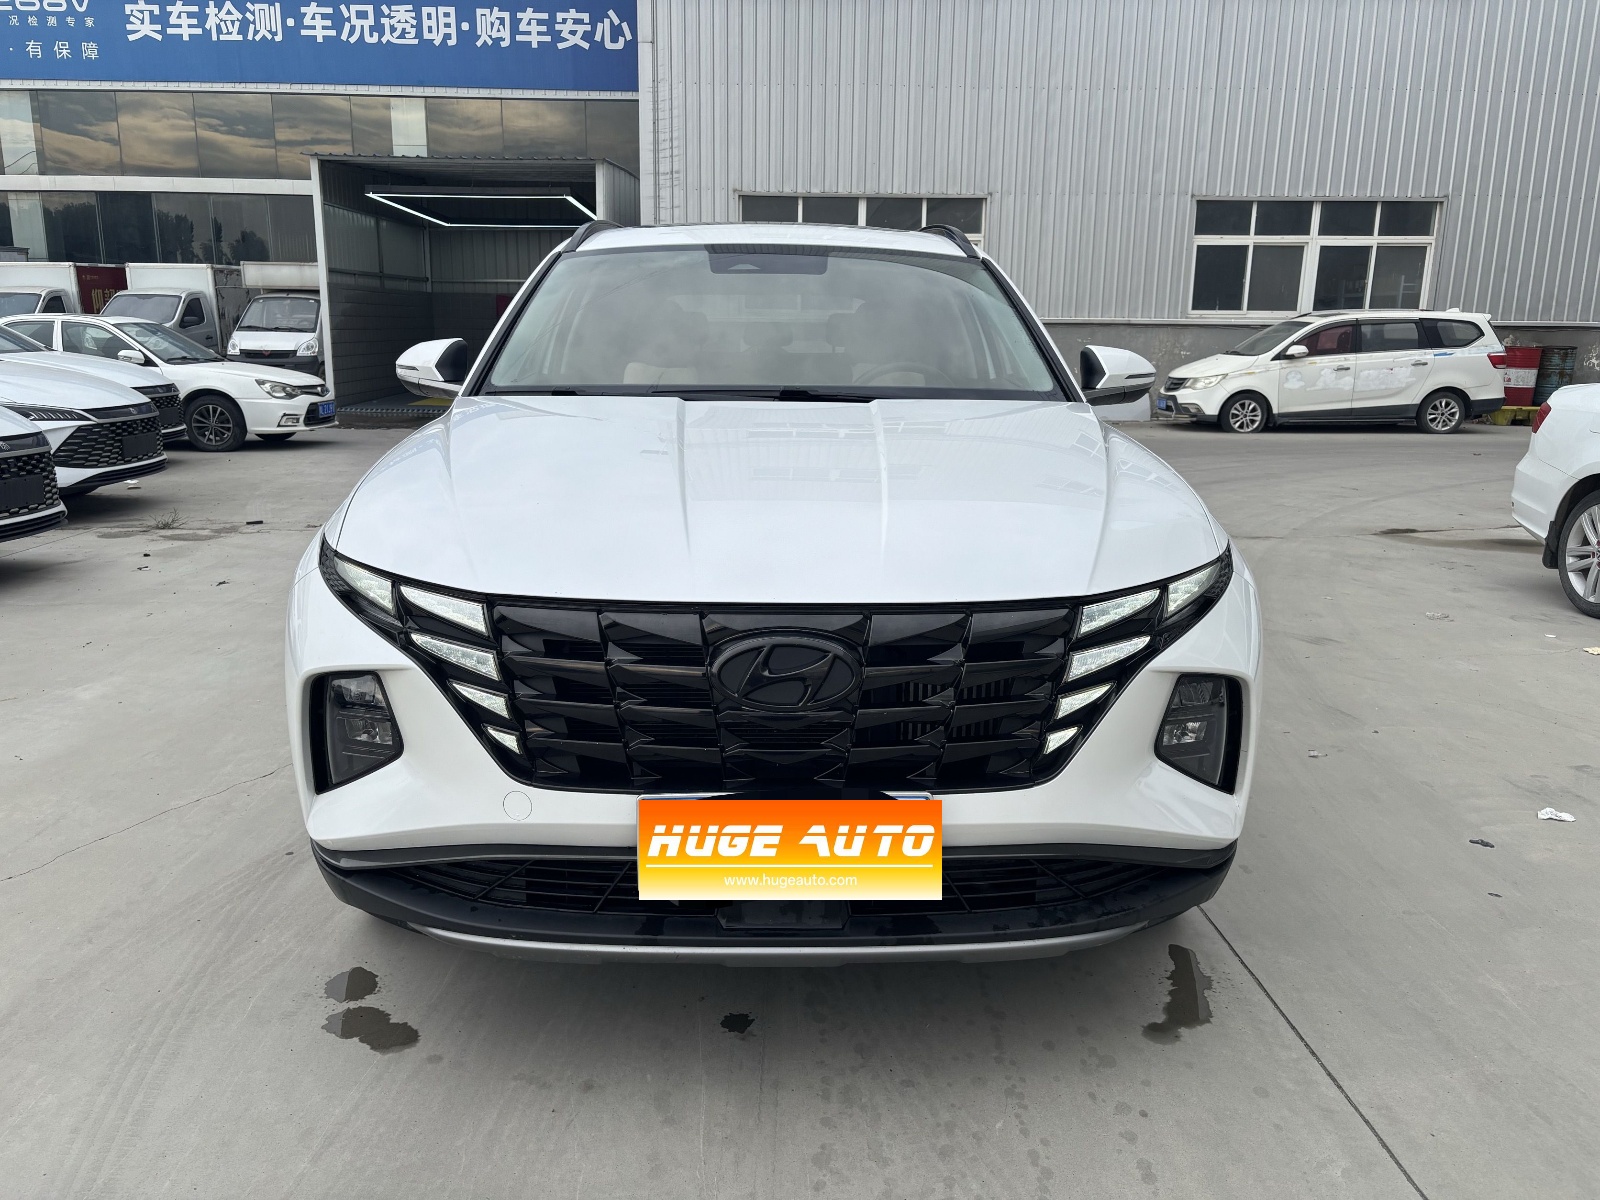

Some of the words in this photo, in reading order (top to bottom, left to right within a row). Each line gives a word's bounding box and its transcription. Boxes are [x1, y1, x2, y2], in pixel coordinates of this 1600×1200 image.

[125, 0, 632, 50] 实车检测·车况透明·购车安心
